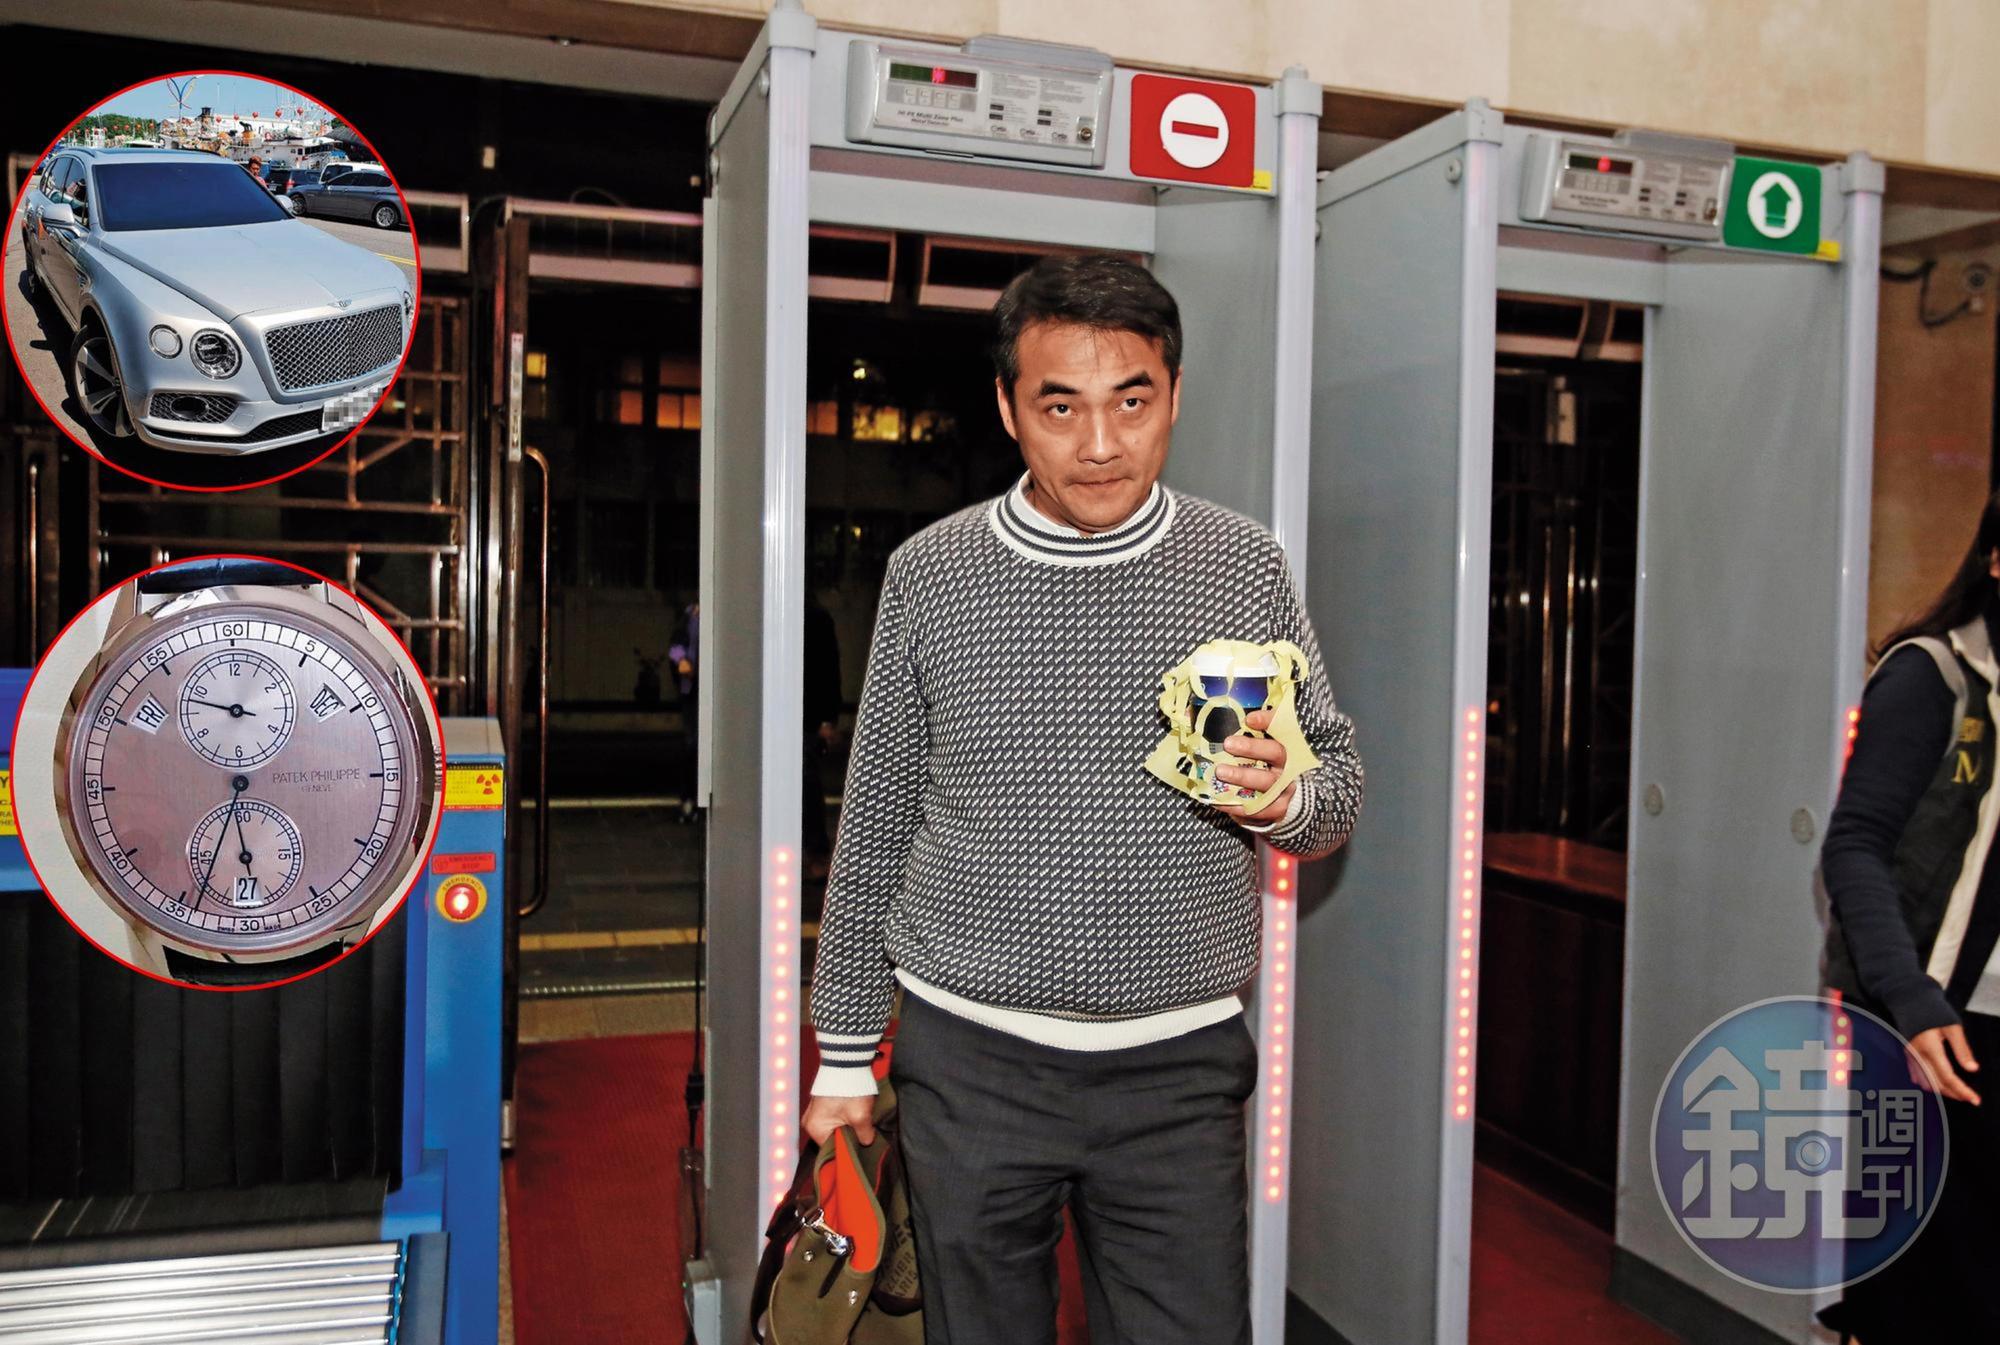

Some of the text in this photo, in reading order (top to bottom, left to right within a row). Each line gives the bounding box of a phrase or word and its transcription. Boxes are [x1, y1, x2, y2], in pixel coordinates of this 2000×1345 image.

[222, 623, 244, 637] 60
[304, 639, 316, 653] 5
[146, 647, 167, 666] 55
[229, 663, 241, 676] 12
[193, 685, 208, 699] 10
[264, 682, 277, 694] 2
[309, 688, 339, 717] DEC
[361, 692, 377, 708] 10
[98, 705, 115, 726] 50
[136, 699, 165, 729] FRI
[197, 728, 209, 738] 8
[267, 724, 279, 733] 4
[235, 745, 243, 758] 6
[272, 768, 360, 784] PATEK PHILIPPE
[386, 768, 398, 782] 15
[87, 779, 100, 800] 45
[235, 810, 251, 824] 60
[278, 848, 291, 860] 15
[366, 839, 384, 859] 20
[110, 851, 128, 870] 40
[200, 850, 213, 865] 45
[238, 877, 257, 900] 27
[165, 901, 187, 918] 35
[311, 895, 332, 912] 25
[240, 920, 260, 932] 30
